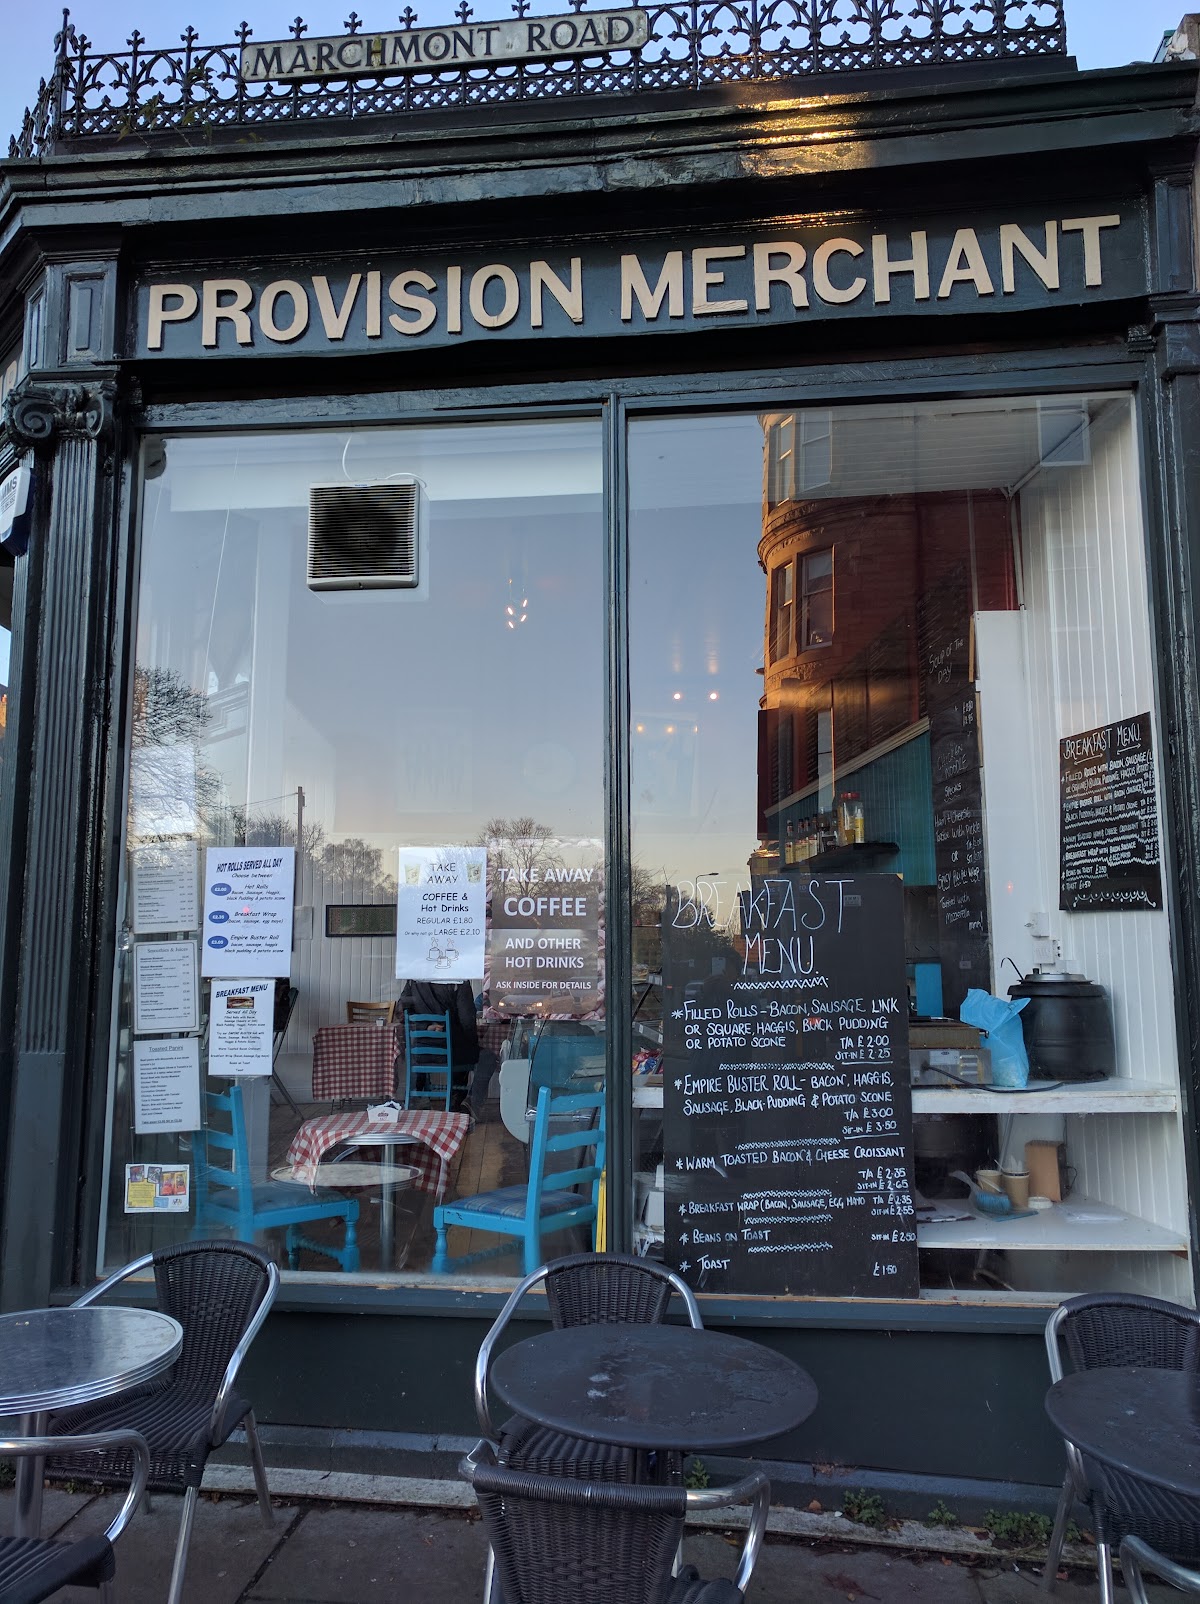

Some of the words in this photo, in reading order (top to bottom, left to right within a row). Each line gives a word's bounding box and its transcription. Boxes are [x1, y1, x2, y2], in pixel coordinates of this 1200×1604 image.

[251, 26, 500, 78] MARCHMONT
[527, 15, 635, 52] ROAD
[147, 257, 584, 350] PROVISION
[620, 214, 1121, 321] MERCHANT
[1063, 728, 1112, 760] BREAKFAST
[1065, 771, 1082, 783] FILLED
[216, 862, 226, 873] HOT
[243, 860, 262, 871] SERVED
[262, 858, 272, 868] ALL
[272, 857, 283, 868] DAY
[430, 862, 456, 872] TAKE
[427, 875, 459, 884] AWAY
[498, 868, 539, 883] TAKE
[544, 868, 594, 883] AWAY
[422, 893, 458, 901] COFFEE
[462, 892, 468, 901] &
[421, 904, 437, 912] Hot
[441, 903, 469, 912] Drinks
[503, 897, 587, 917] COFFEE
[672, 879, 854, 933] BREAKFAST
[416, 917, 450, 925] REGULAR
[433, 928, 458, 936] LARGE
[505, 938, 534, 949] AND
[538, 938, 581, 950] OTHER
[743, 931, 819, 976] MENU.
[505, 956, 533, 968] HOT
[536, 956, 584, 969] DRINKS
[215, 986, 249, 998] BREAKFAST
[250, 984, 269, 993] MENU
[496, 981, 512, 989] ASK
[513, 981, 540, 989] INSIDE
[542, 981, 558, 989] FOR
[559, 981, 592, 990] DETAILS
[683, 999, 722, 1020] FILLED
[726, 999, 758, 1019] ROLLS
[811, 998, 866, 1015] SAUSAGE
[872, 997, 900, 1014] LINK
[685, 1024, 702, 1036] OR
[802, 1018, 832, 1032] BLACK
[839, 1016, 888, 1031] PUDDING
[686, 1038, 702, 1049] OR
[708, 1036, 746, 1048] POTATO
[751, 1036, 786, 1048] SCONE
[683, 1073, 722, 1096] EMPIRE
[727, 1075, 768, 1095] BUSTER
[853, 1071, 894, 1087] HAGGIS,
[822, 1092, 855, 1105] POTATO
[860, 1091, 893, 1104] SCONE
[686, 1157, 715, 1170] WARM
[721, 1152, 767, 1166] TOASTED
[772, 1150, 805, 1164] BACON
[816, 1147, 850, 1162] CHEESE
[854, 1146, 906, 1159] CROISSANT
[688, 1201, 733, 1215] BREAKFAST
[737, 1200, 759, 1213] WRAP
[846, 1196, 866, 1207] MAYO
[692, 1231, 722, 1244] BEANS
[724, 1233, 738, 1242] ON
[741, 1228, 771, 1242] TOAST
[697, 1255, 730, 1270] TOAST
